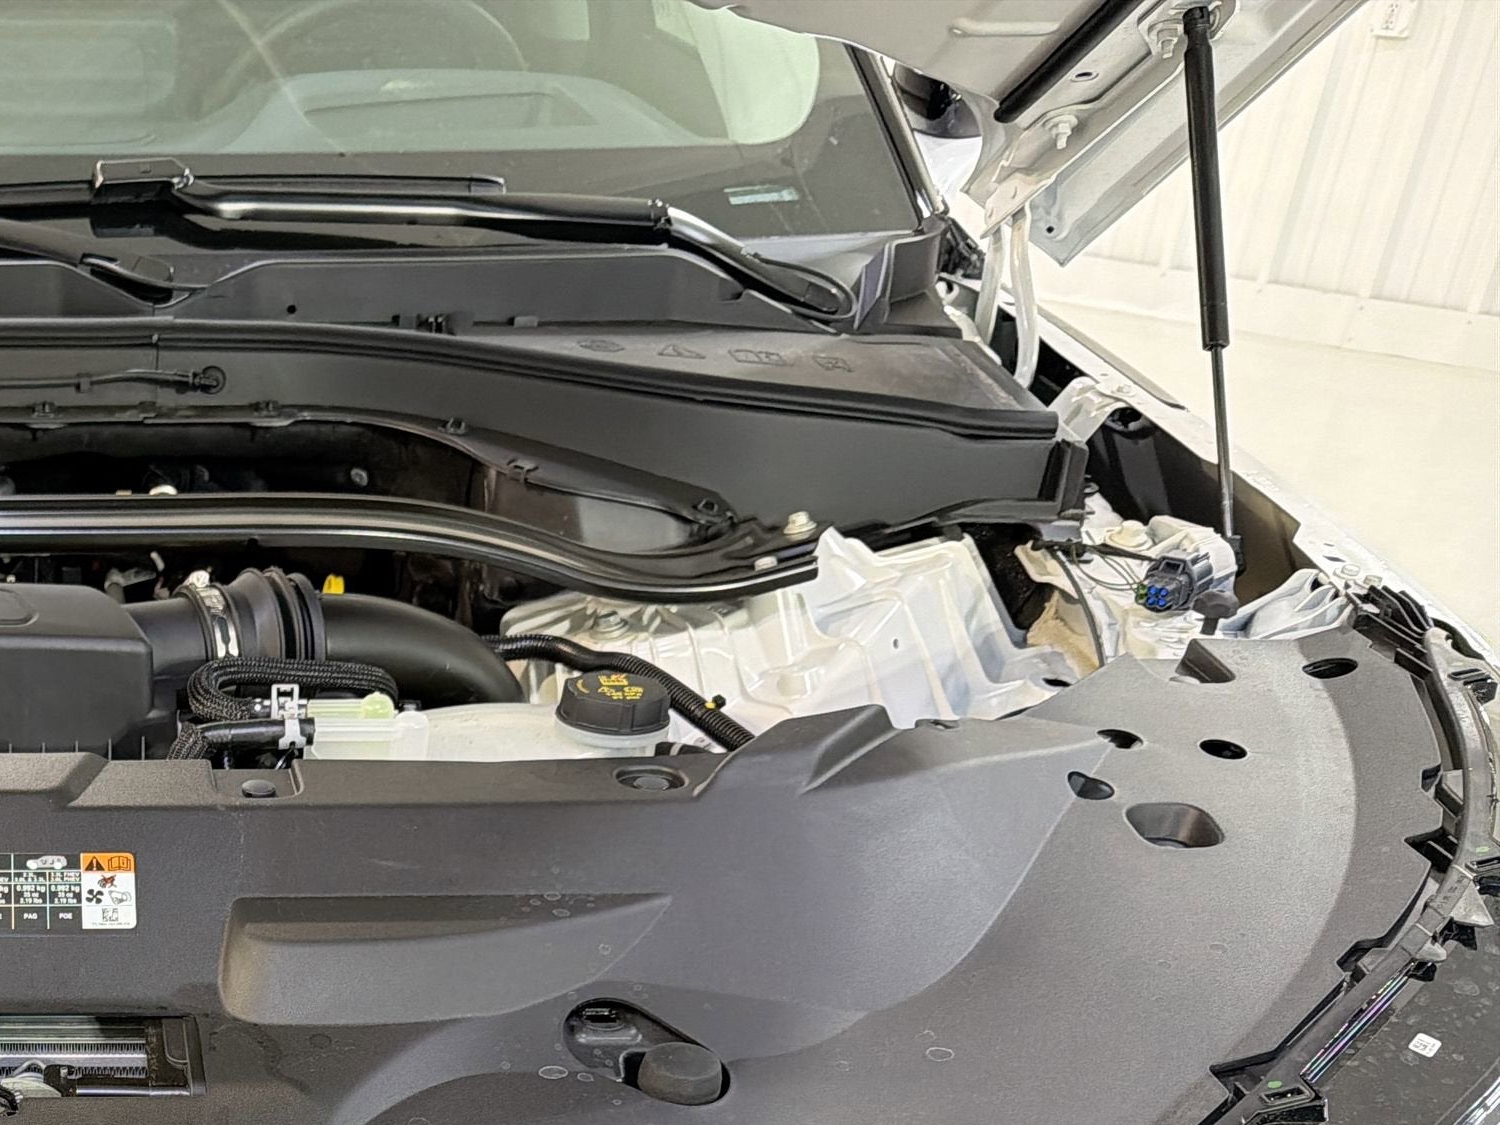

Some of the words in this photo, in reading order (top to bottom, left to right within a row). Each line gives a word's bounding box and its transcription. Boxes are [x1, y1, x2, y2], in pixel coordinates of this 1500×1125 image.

[0, 885, 9, 893] kg
[36, 885, 46, 893] kg
[71, 885, 80, 893] kg
